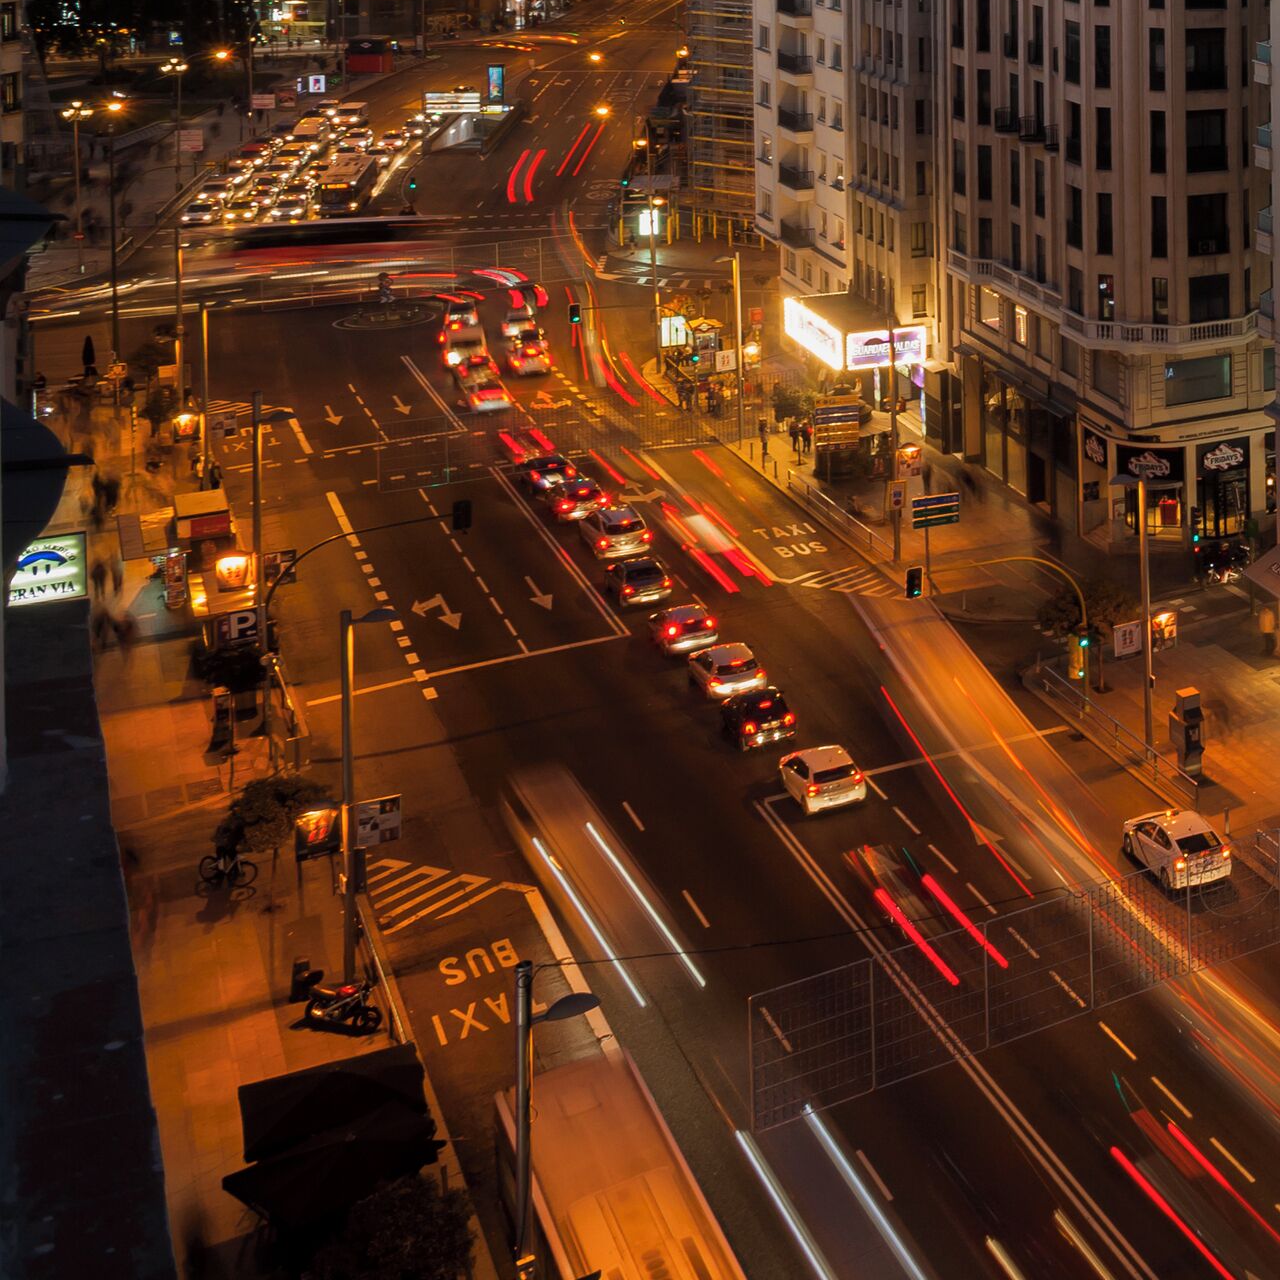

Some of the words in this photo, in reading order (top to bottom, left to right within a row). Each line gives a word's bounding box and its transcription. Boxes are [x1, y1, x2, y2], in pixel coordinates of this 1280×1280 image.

[222, 437, 281, 453] TXI
[752, 522, 816, 540] TAXI
[772, 541, 828, 558] BUS
[8, 584, 47, 602] GRAN
[50, 580, 76, 594] VIA
[230, 611, 257, 639] P
[438, 937, 521, 986] BUS
